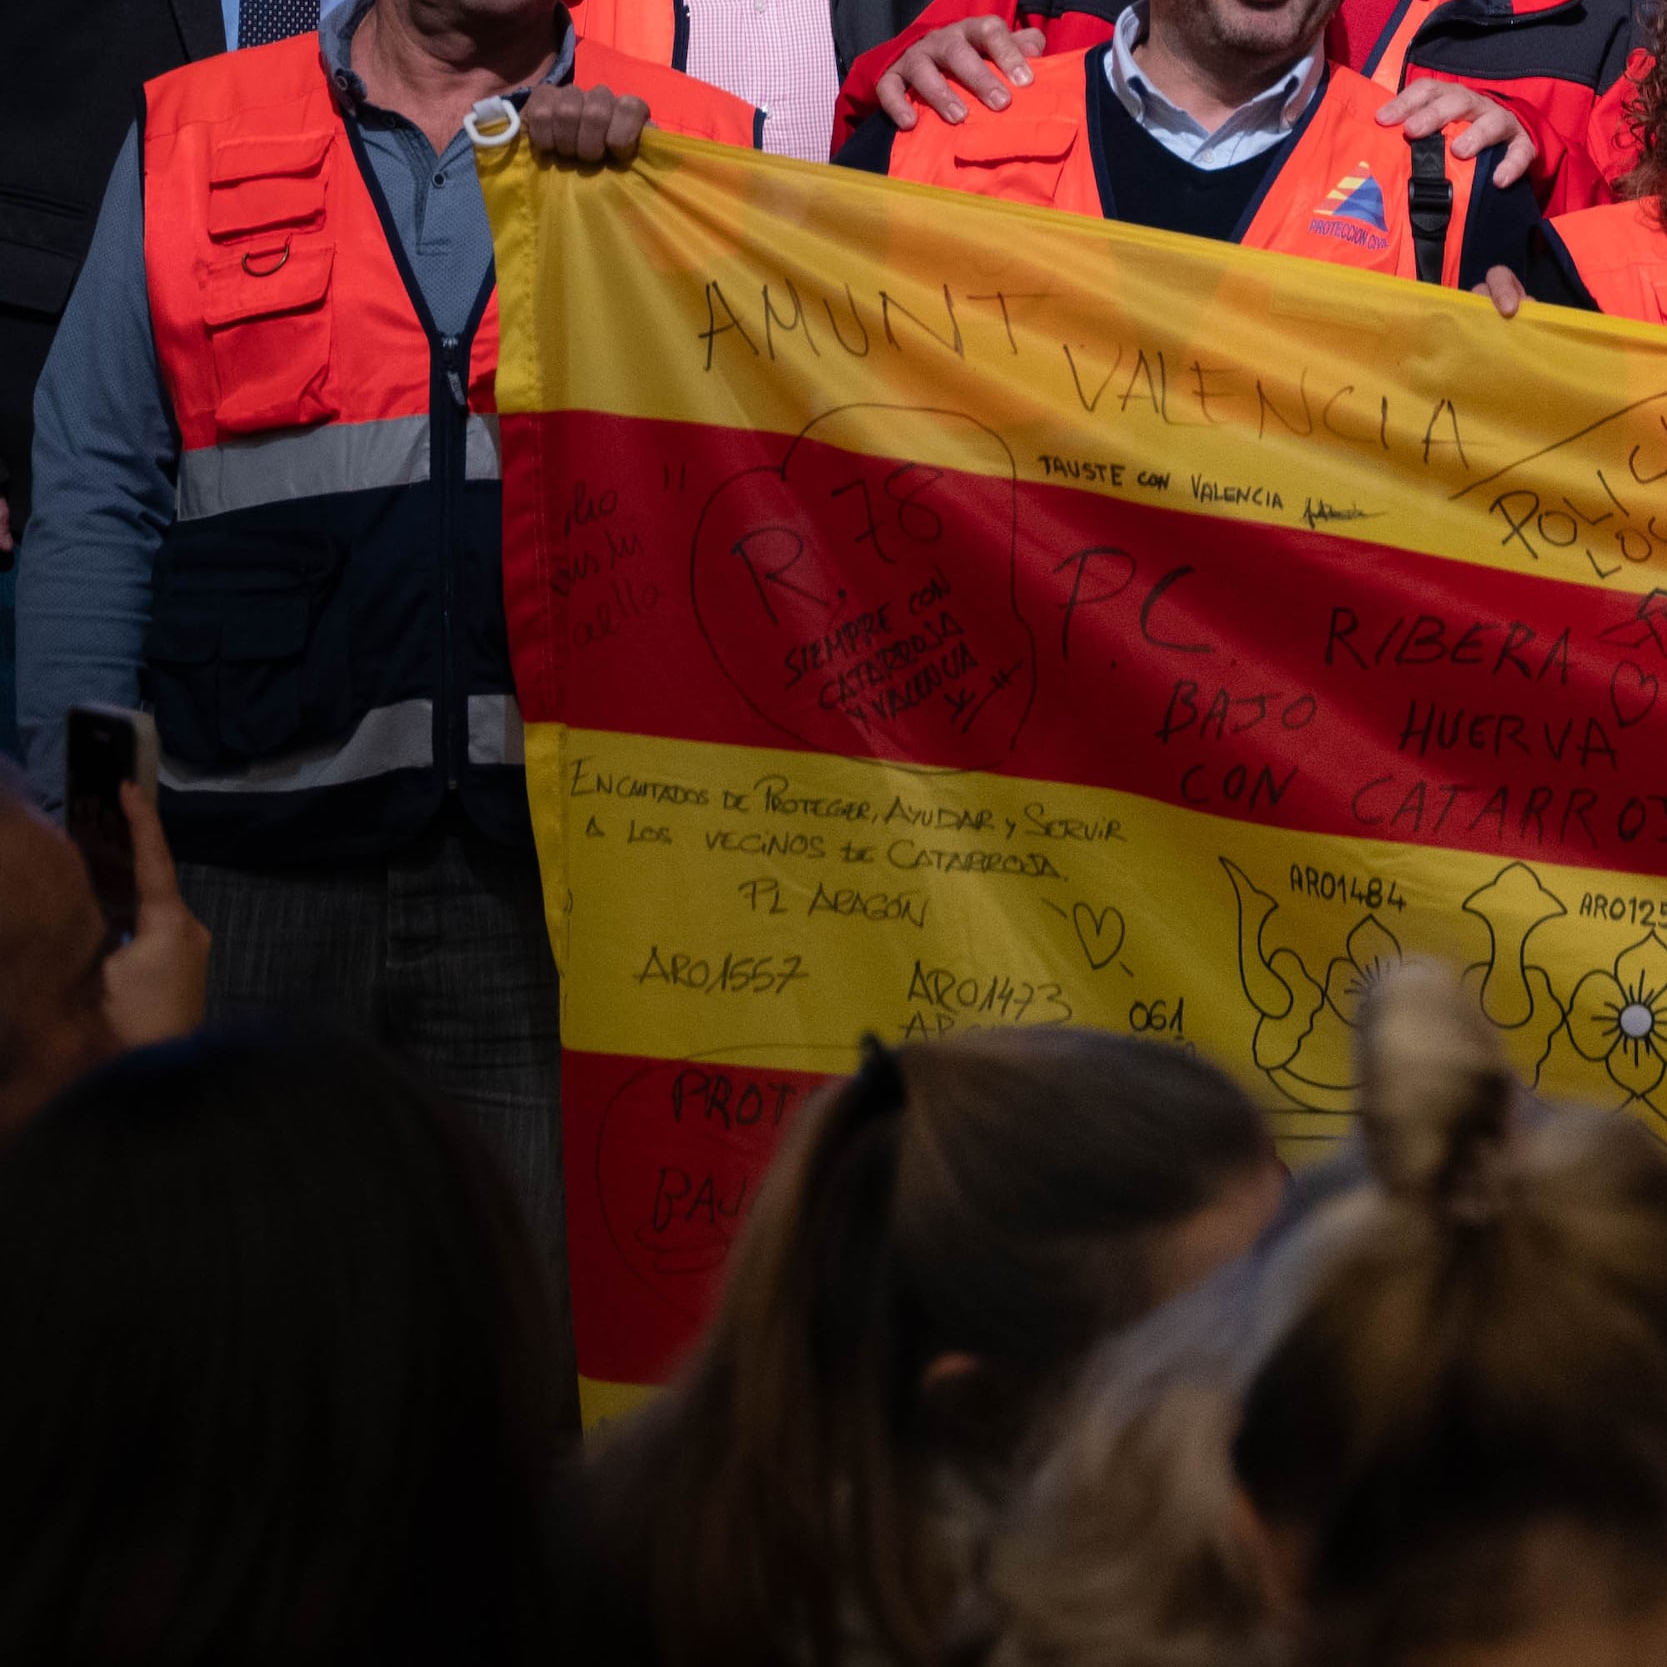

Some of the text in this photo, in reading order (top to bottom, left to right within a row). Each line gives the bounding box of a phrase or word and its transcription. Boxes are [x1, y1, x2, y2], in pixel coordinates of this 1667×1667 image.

[699, 278, 1055, 372] AMUNT
[1063, 342, 1490, 472] VALENCIA
[1039, 453, 1285, 513] TAUSTE CON VALENCIA
[906, 559, 953, 616] CON
[1323, 605, 1573, 686] RIBERA
[1154, 679, 1620, 772] BAJO HUERVA
[884, 794, 996, 831] AYUDAR
[1180, 762, 1300, 814] CON
